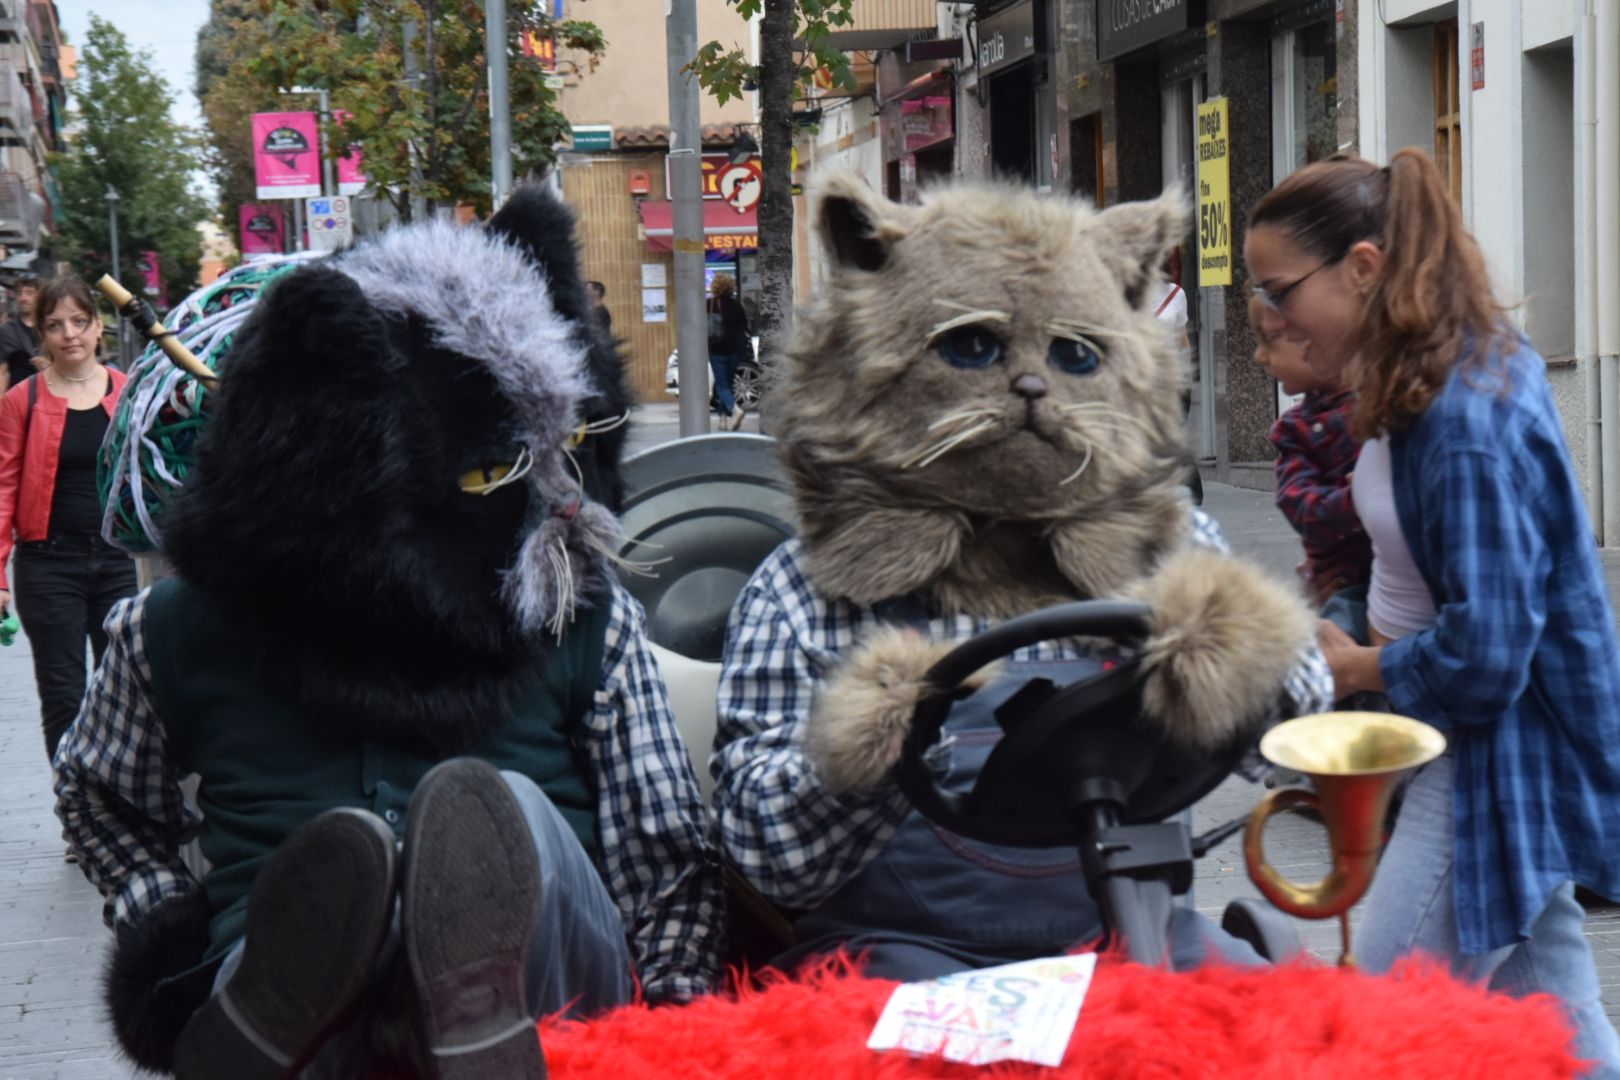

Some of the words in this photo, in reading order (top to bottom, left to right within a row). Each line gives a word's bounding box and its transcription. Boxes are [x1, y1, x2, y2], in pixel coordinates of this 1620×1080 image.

[1199, 109, 1220, 139] mega
[1200, 139, 1226, 162] REBAIXES
[1201, 180, 1210, 197] fins
[1201, 202, 1228, 249] 50%
[1202, 253, 1228, 270] descompte
